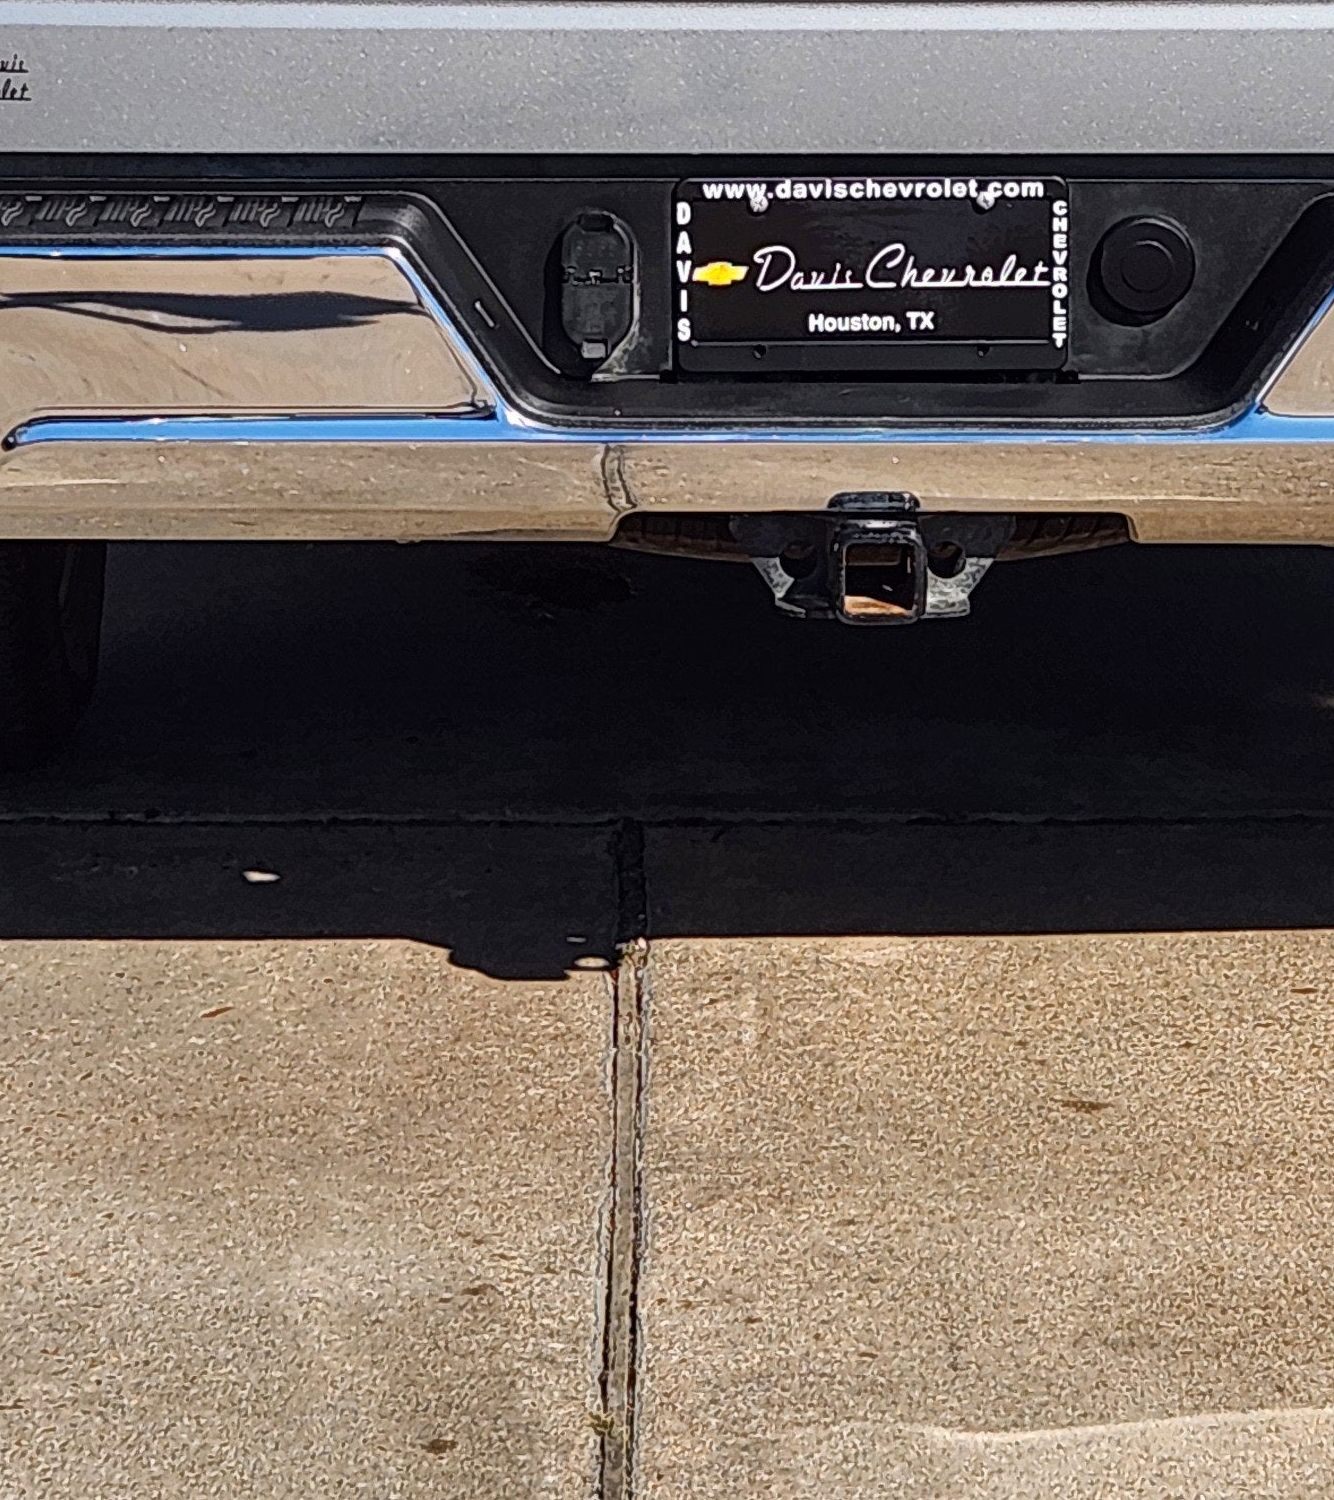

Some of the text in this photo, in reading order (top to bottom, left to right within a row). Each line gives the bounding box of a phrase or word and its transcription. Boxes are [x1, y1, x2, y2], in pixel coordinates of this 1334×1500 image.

[703, 178, 1044, 200] www.davischevrolet.com
[676, 202, 692, 342] DAVIS
[753, 243, 1051, 291] Davis Chevrolet
[1052, 200, 1067, 348] CHEVROLET
[808, 311, 935, 334] Houston, TX
